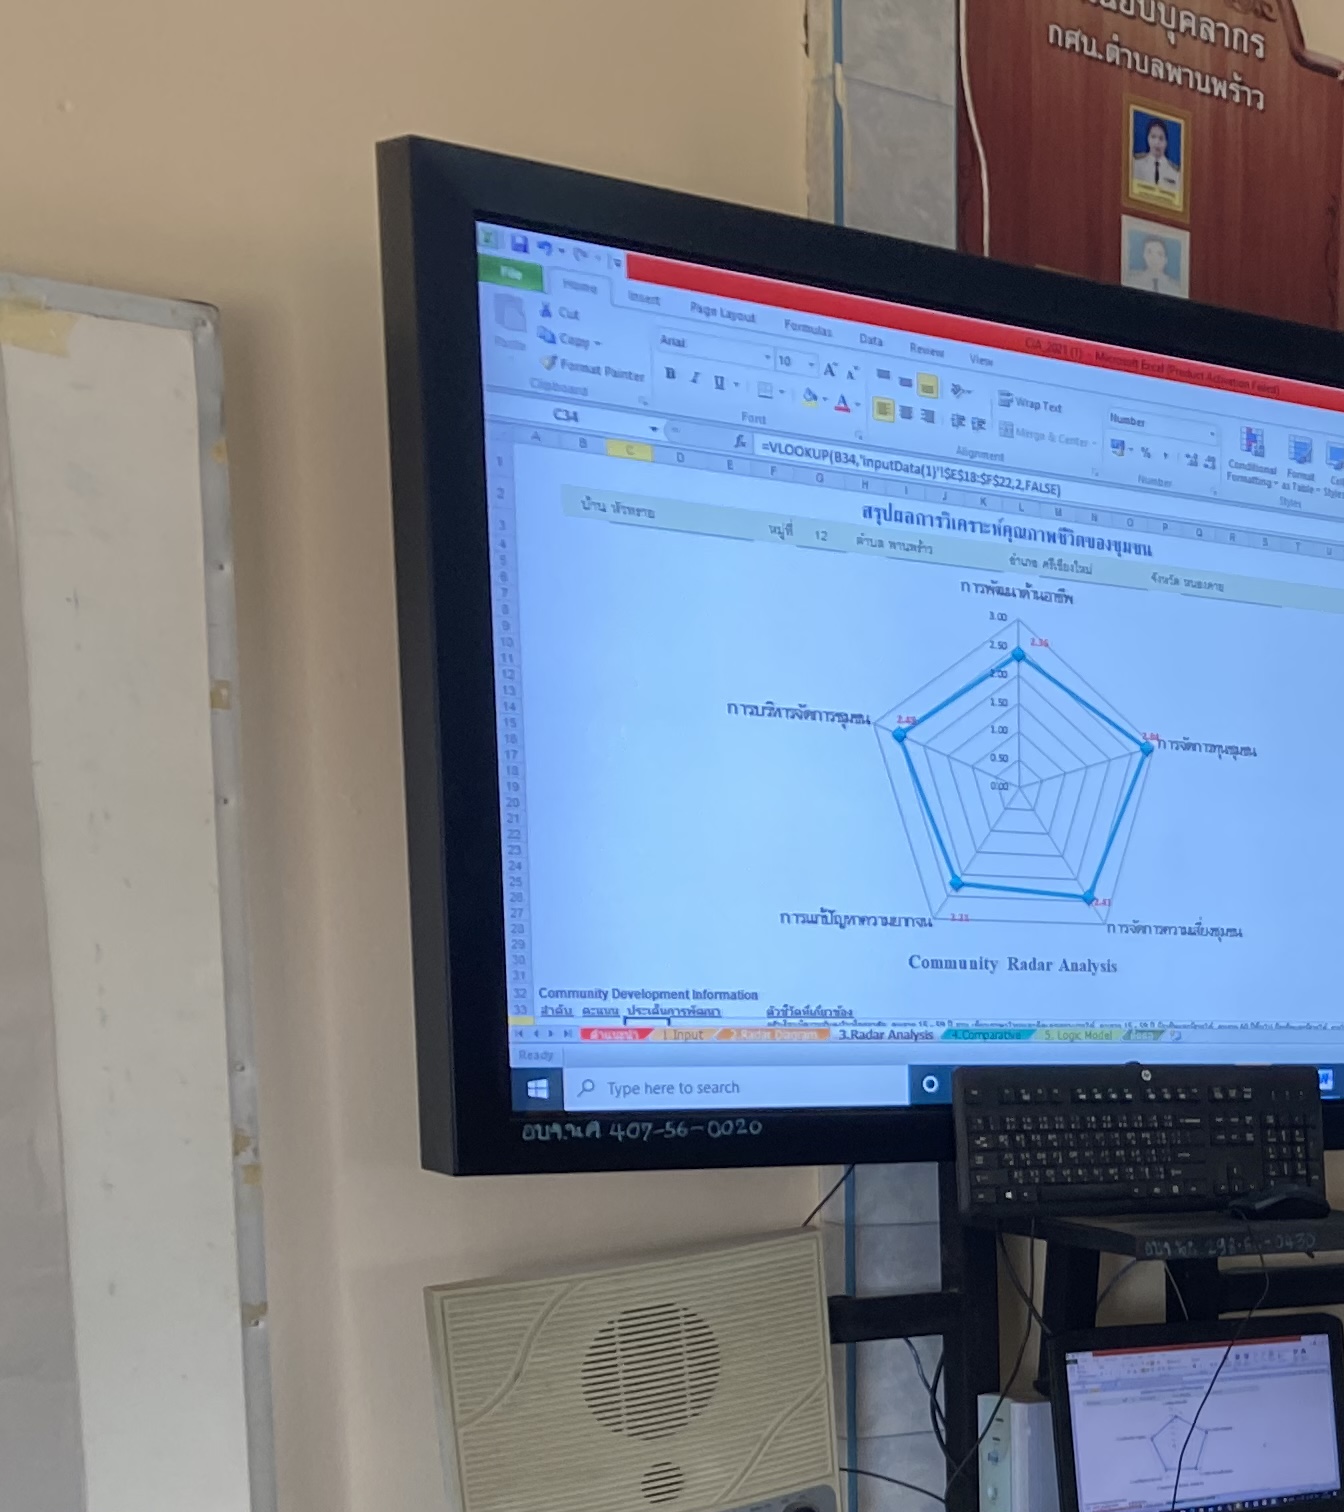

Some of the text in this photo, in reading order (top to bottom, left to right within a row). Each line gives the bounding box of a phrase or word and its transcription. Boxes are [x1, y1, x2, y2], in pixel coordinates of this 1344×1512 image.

[1048, 22, 1265, 110] กศน.ตำบลพานพร้าว
[558, 306, 579, 321] Cut
[779, 355, 791, 367] 10
[559, 333, 590, 349] Copy
[690, 301, 718, 318] Page
[720, 306, 756, 324] Layout
[784, 318, 833, 339] Formulas
[860, 333, 883, 347] Data
[910, 342, 945, 359] Review
[969, 353, 994, 368] View
[560, 358, 645, 383] Format Painter
[1042, 401, 1062, 414] Text
[1110, 413, 1145, 427] Number
[581, 495, 607, 513] บ้าน
[816, 530, 828, 542] 12
[862, 502, 1152, 558] สรุปผลการวิเคราะห์คุณภาพชีวิตของชุมชน
[908, 954, 1118, 976] Community Radar Analysis
[539, 988, 759, 1001] Community Development Information
[838, 1029, 934, 1042] 3.Radar Analysis
[518, 1049, 554, 1062] Ready
[608, 1080, 740, 1097] Type here to search
